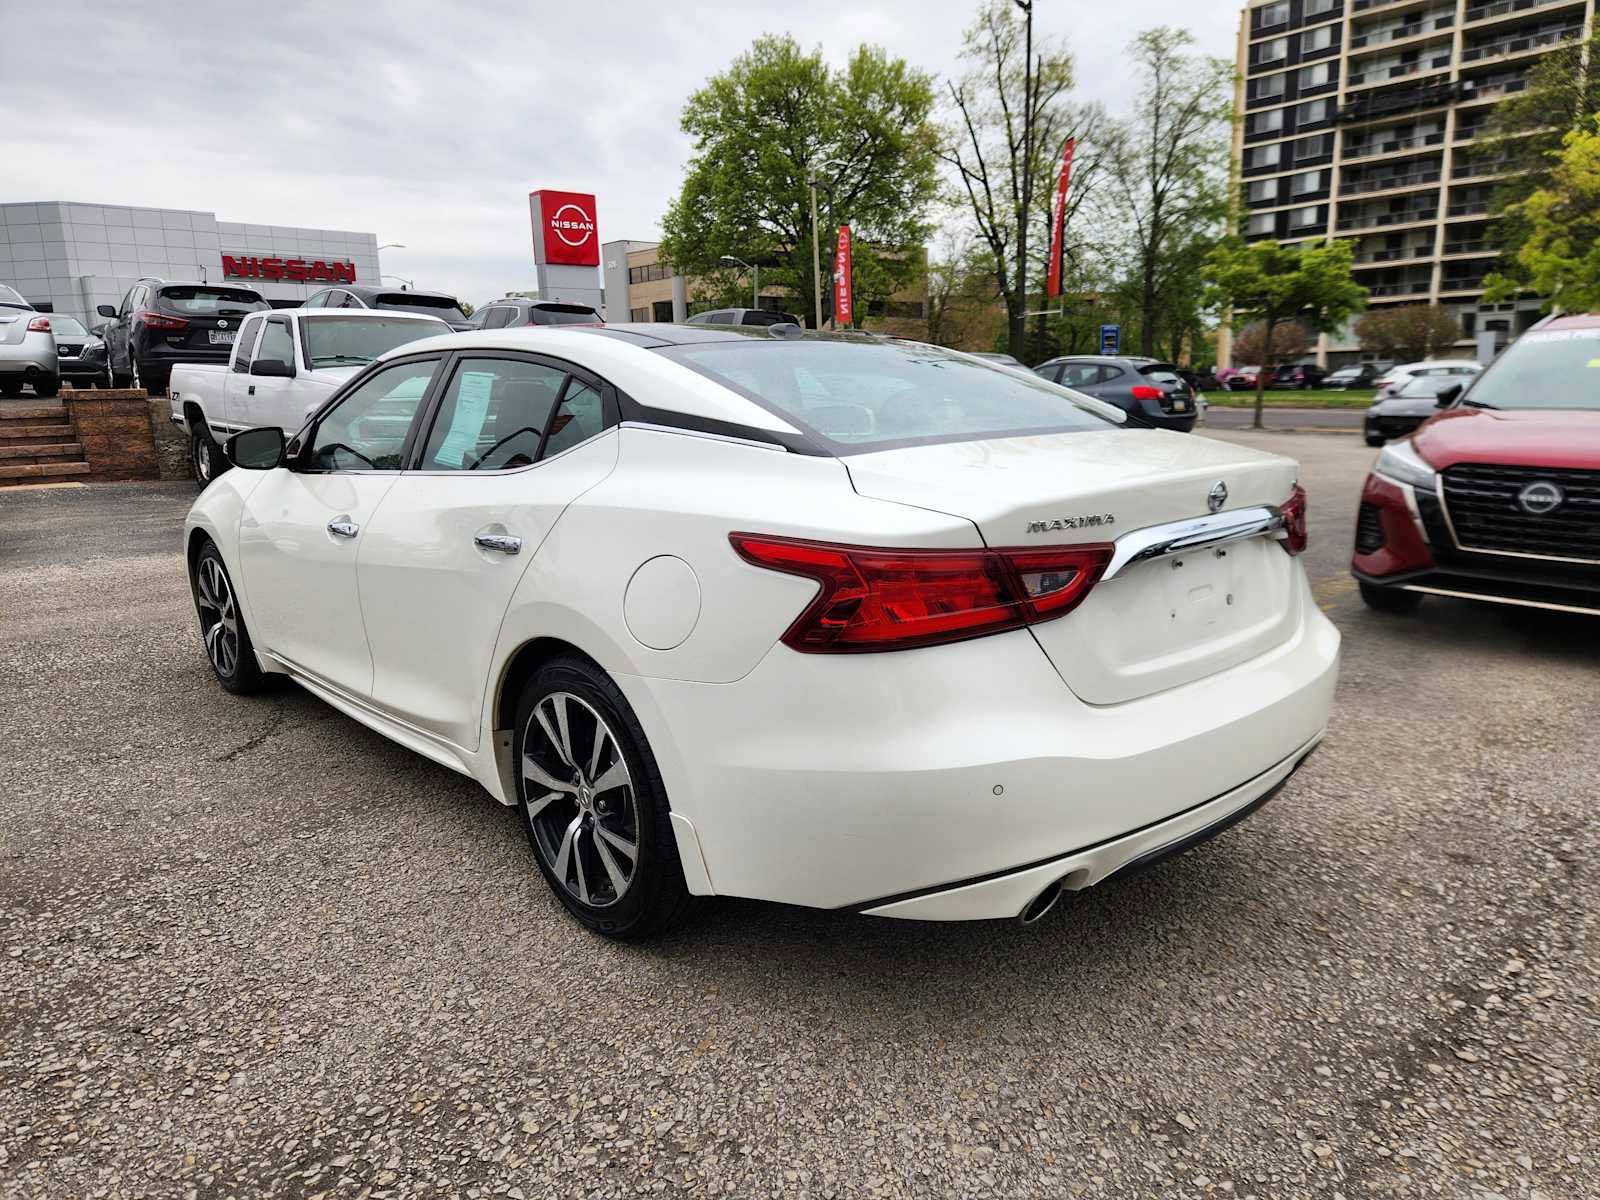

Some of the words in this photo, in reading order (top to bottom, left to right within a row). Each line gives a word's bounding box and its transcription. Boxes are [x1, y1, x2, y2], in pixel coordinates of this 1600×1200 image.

[551, 220, 594, 230] NISSAN
[222, 255, 357, 284] NISSAN
[1026, 512, 1115, 534] MAXIMA
